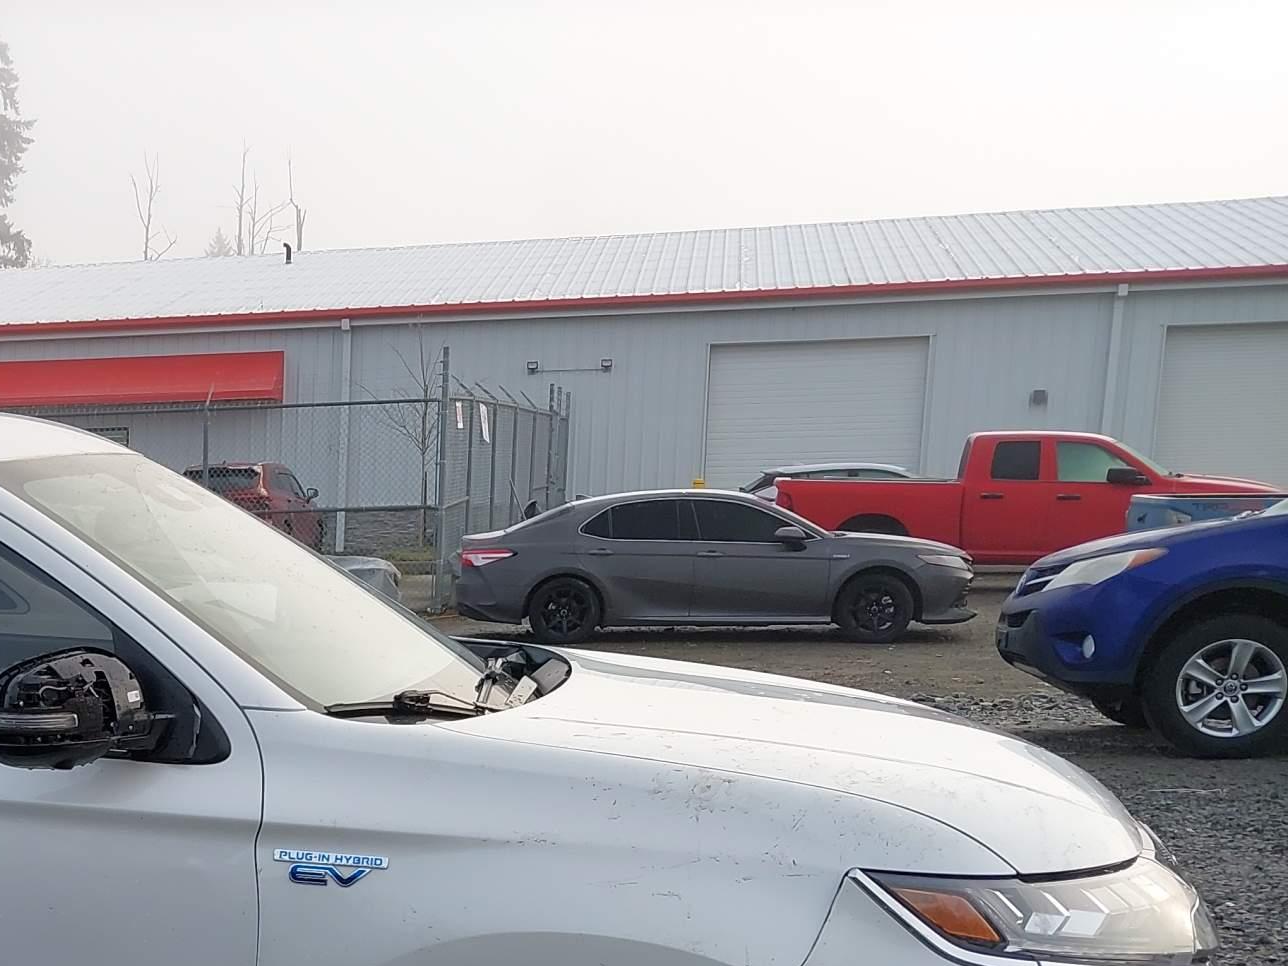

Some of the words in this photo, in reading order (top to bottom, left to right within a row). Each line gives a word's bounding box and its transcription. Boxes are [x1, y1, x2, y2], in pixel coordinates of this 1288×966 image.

[279, 851, 330, 862] PLUG-IN
[334, 855, 383, 866] HYBRID
[289, 863, 372, 887] EV
